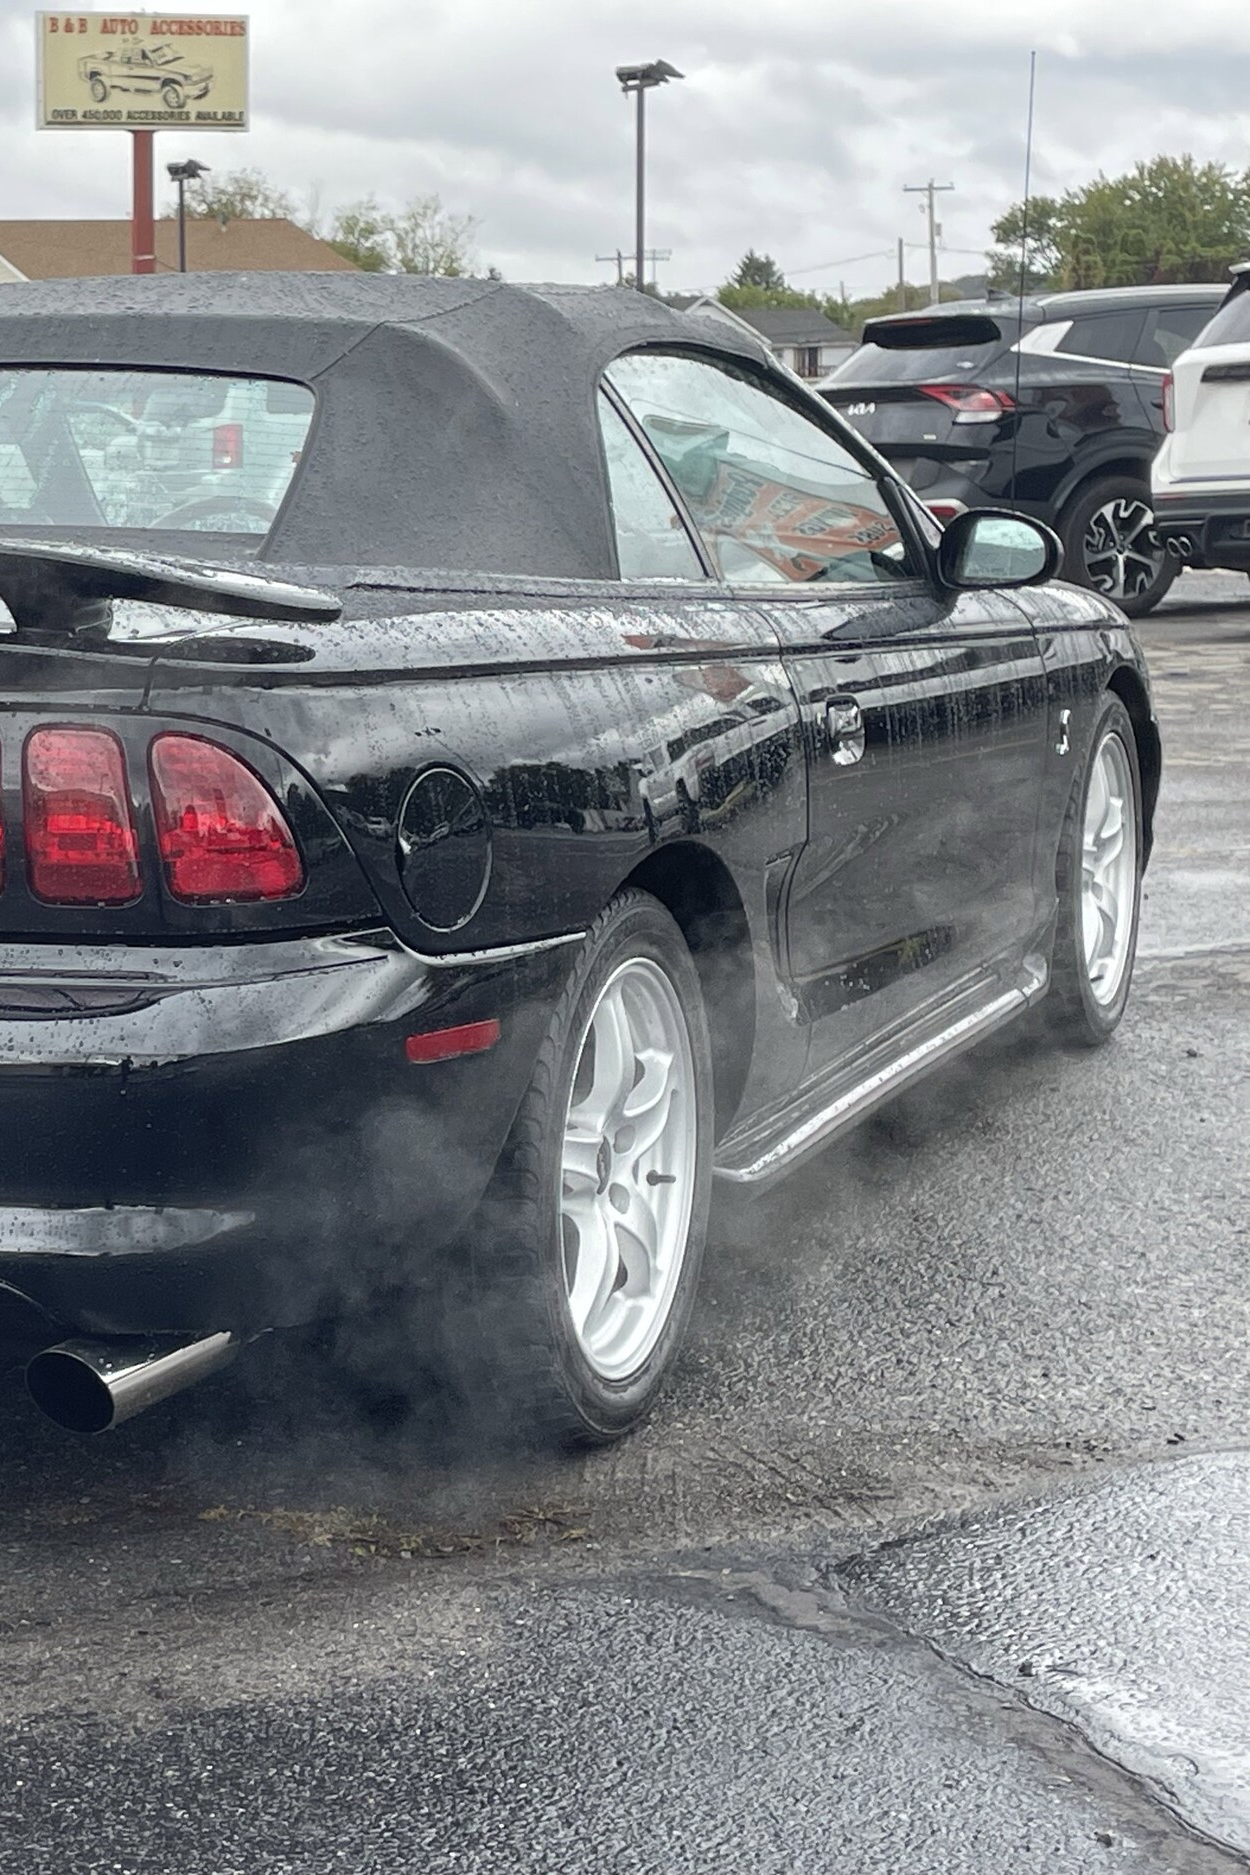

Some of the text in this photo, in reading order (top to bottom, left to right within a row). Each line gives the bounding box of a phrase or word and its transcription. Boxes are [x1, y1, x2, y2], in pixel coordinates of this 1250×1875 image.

[49, 17, 247, 37] B & B AUTO ACCESSORIES
[51, 109, 78, 121] OVER
[126, 110, 190, 121] ACCESSORIES
[194, 111, 244, 121] AVAILABLE
